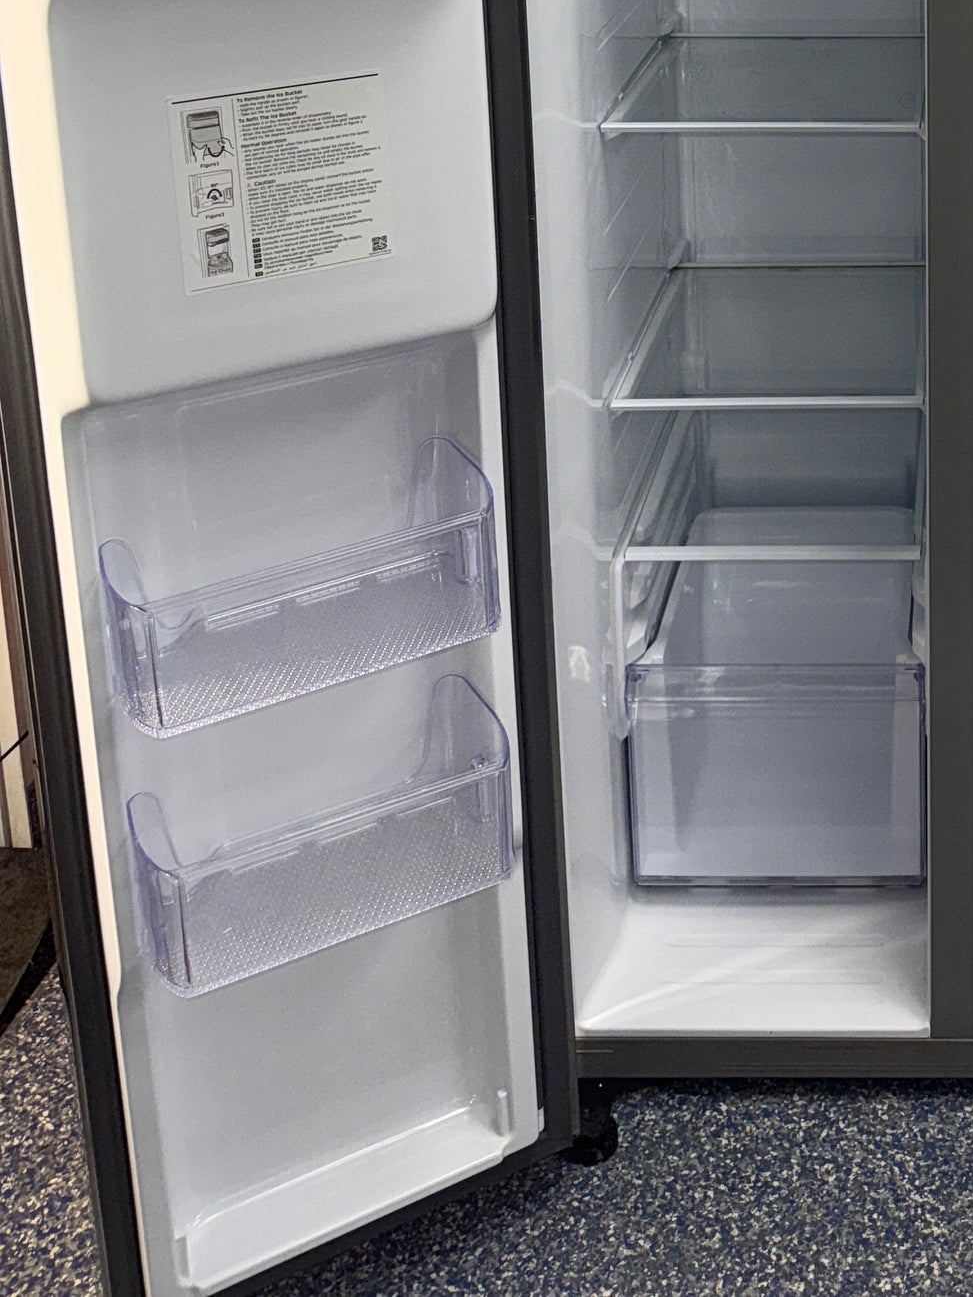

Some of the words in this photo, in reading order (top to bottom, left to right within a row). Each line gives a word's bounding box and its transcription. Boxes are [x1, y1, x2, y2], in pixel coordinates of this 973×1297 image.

[284, 89, 303, 97] Bucket
[278, 110, 297, 118] Bucket
[240, 140, 260, 149] Normal
[261, 137, 287, 147] Operation
[253, 178, 276, 187] Caution
